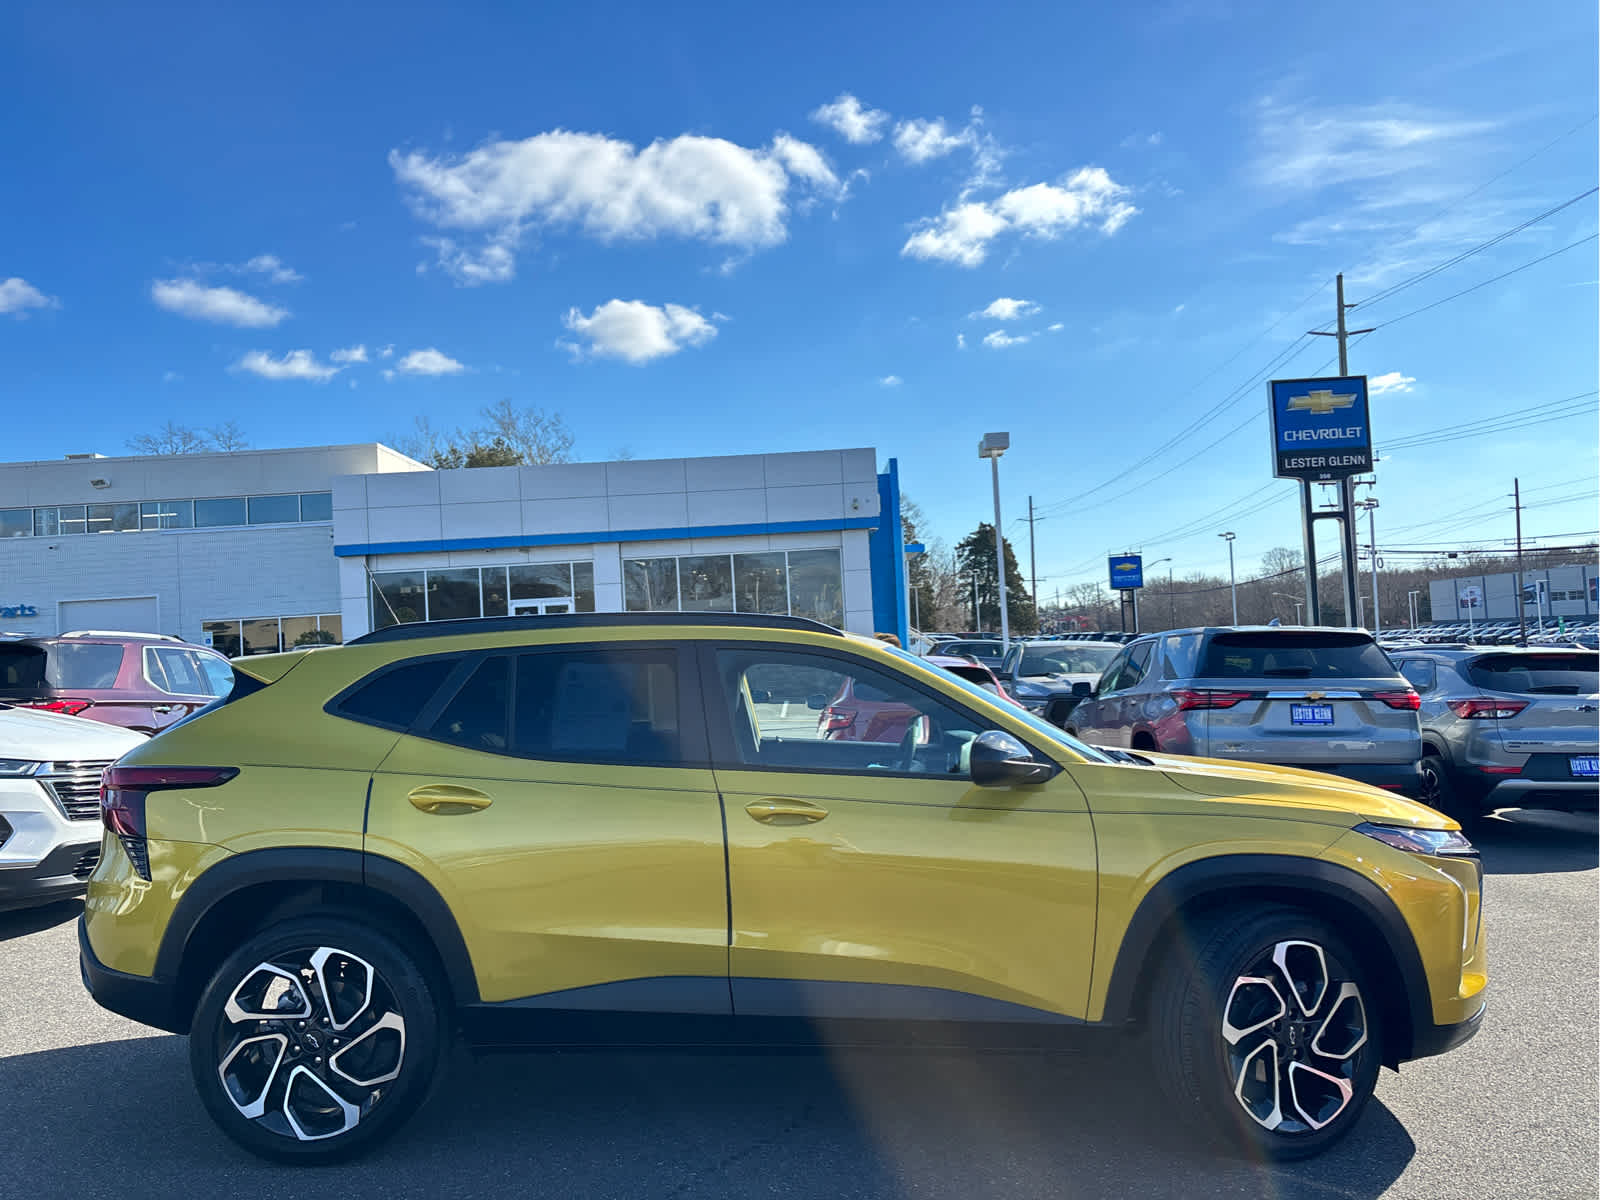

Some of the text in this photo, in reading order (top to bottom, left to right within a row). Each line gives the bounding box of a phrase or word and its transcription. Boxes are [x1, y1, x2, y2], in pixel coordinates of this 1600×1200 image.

[1284, 427, 1363, 442] CHEVROLET
[1285, 455, 1366, 469] LESTER GLENN
[0, 604, 39, 618] arts
